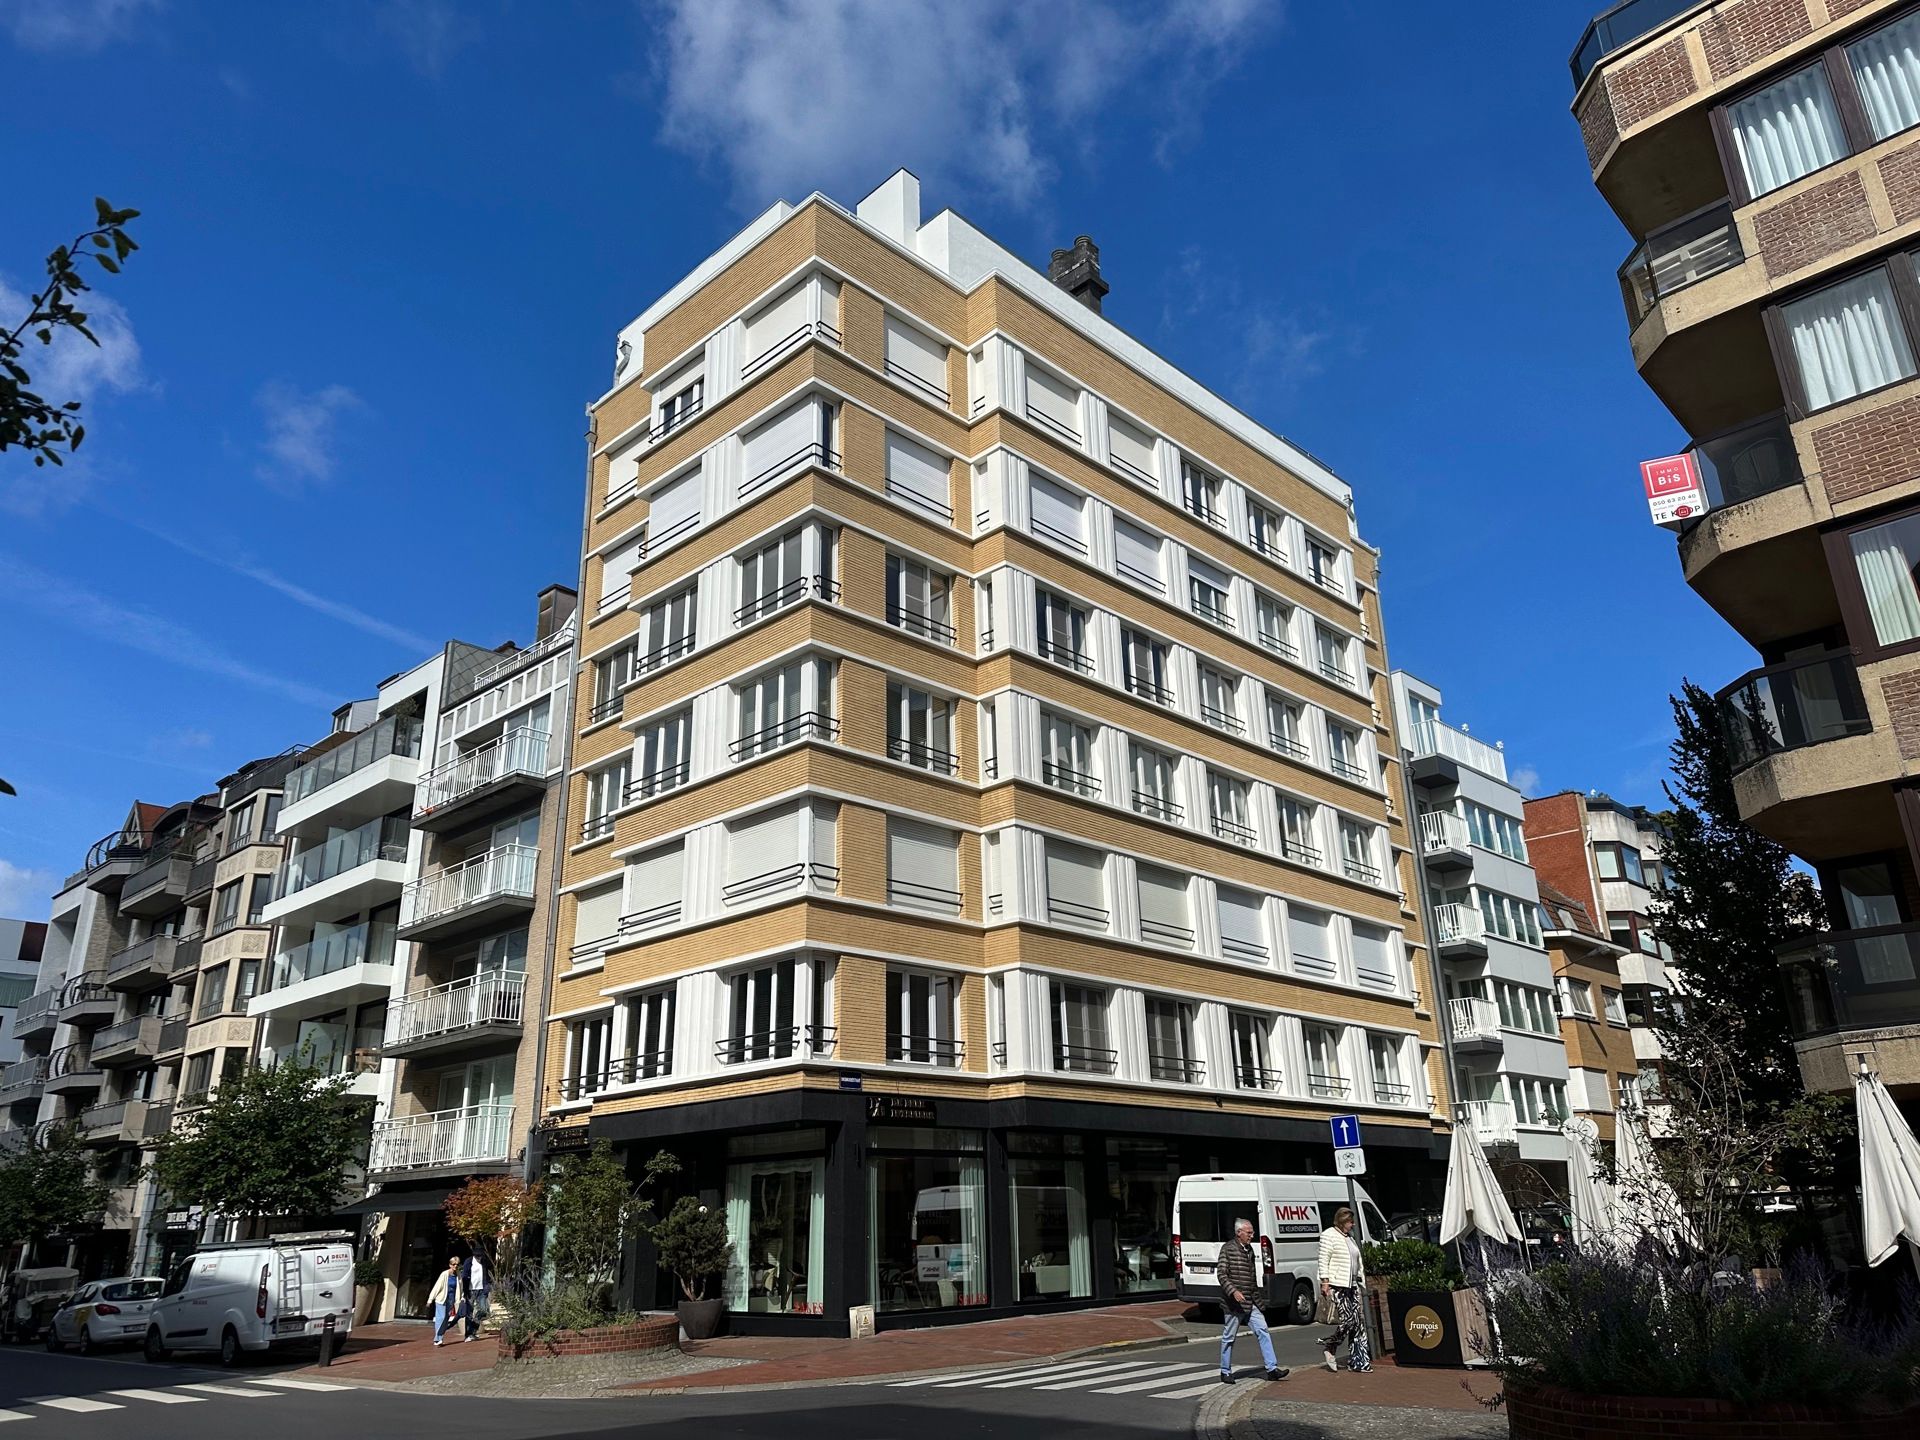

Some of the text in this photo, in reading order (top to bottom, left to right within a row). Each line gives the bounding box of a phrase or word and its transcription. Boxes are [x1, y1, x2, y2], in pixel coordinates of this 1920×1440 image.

[1655, 467, 1679, 475] IMMO
[1658, 474, 1681, 485] BiS
[1654, 511, 1667, 521] TE
[1671, 505, 1701, 518] KP
[1275, 1206, 1310, 1221] MHK
[1408, 1321, 1439, 1331] françois
